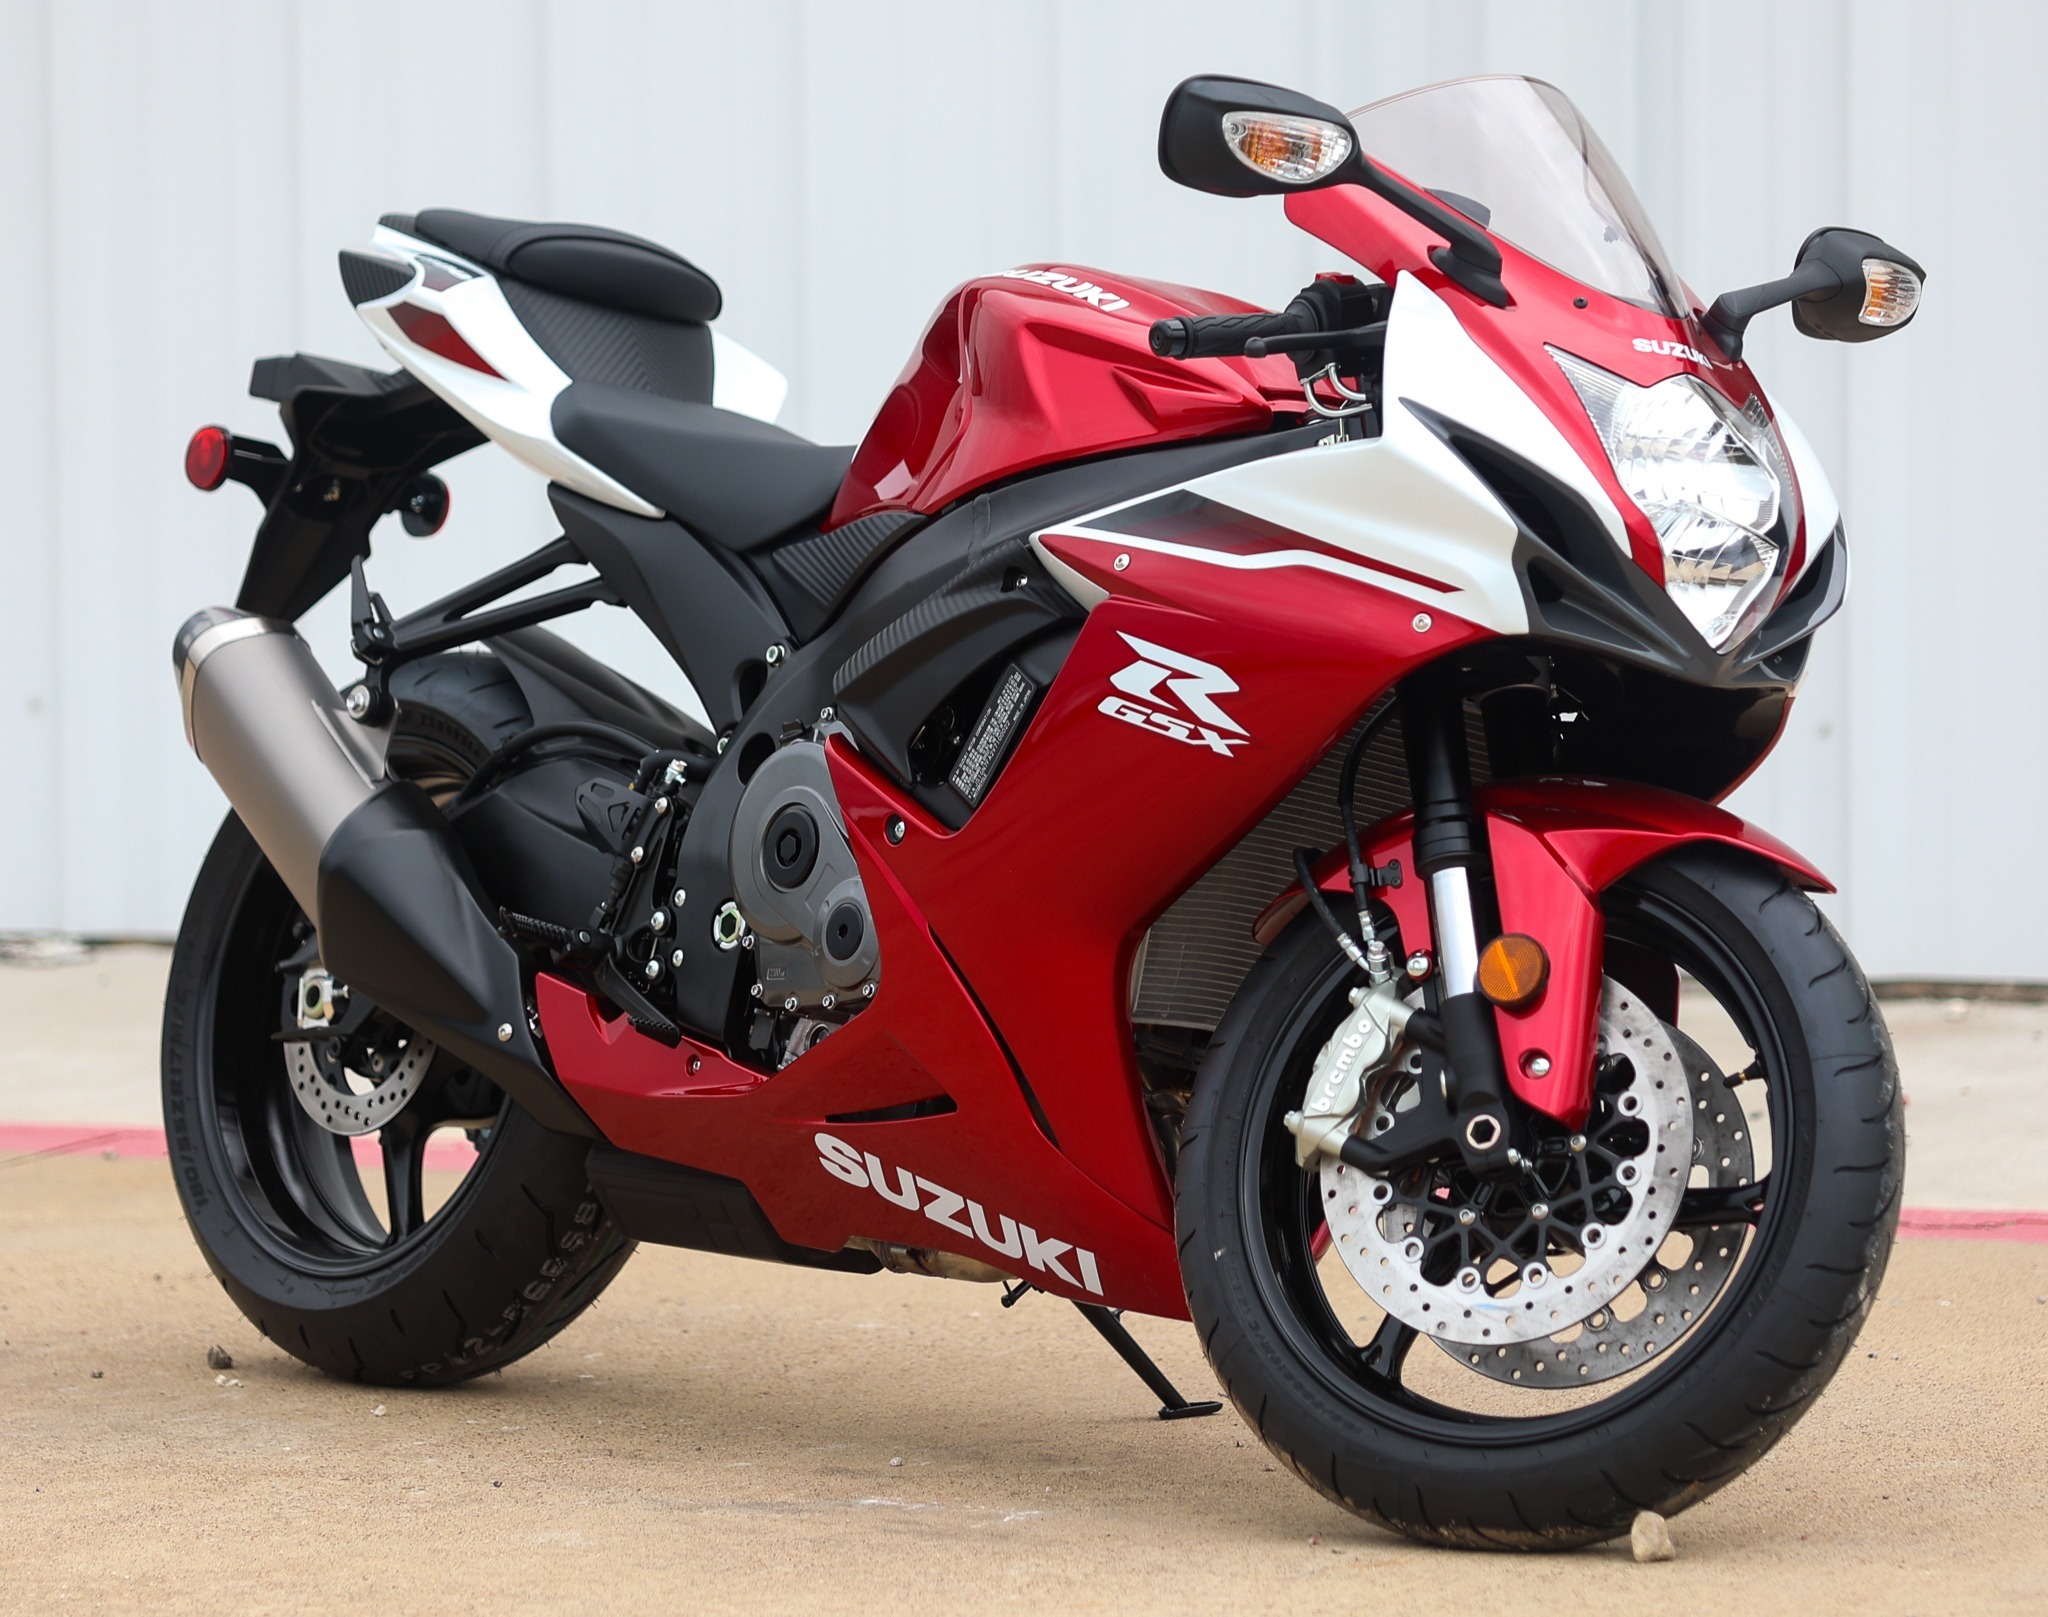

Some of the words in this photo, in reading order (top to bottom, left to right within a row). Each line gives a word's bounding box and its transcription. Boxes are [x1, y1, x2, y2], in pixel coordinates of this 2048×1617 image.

[979, 269, 1130, 313] UZUKI
[1097, 695, 1250, 758] GSX
[1310, 1019, 1373, 1112] brembo
[814, 1132, 1104, 1296] SUZUKI
